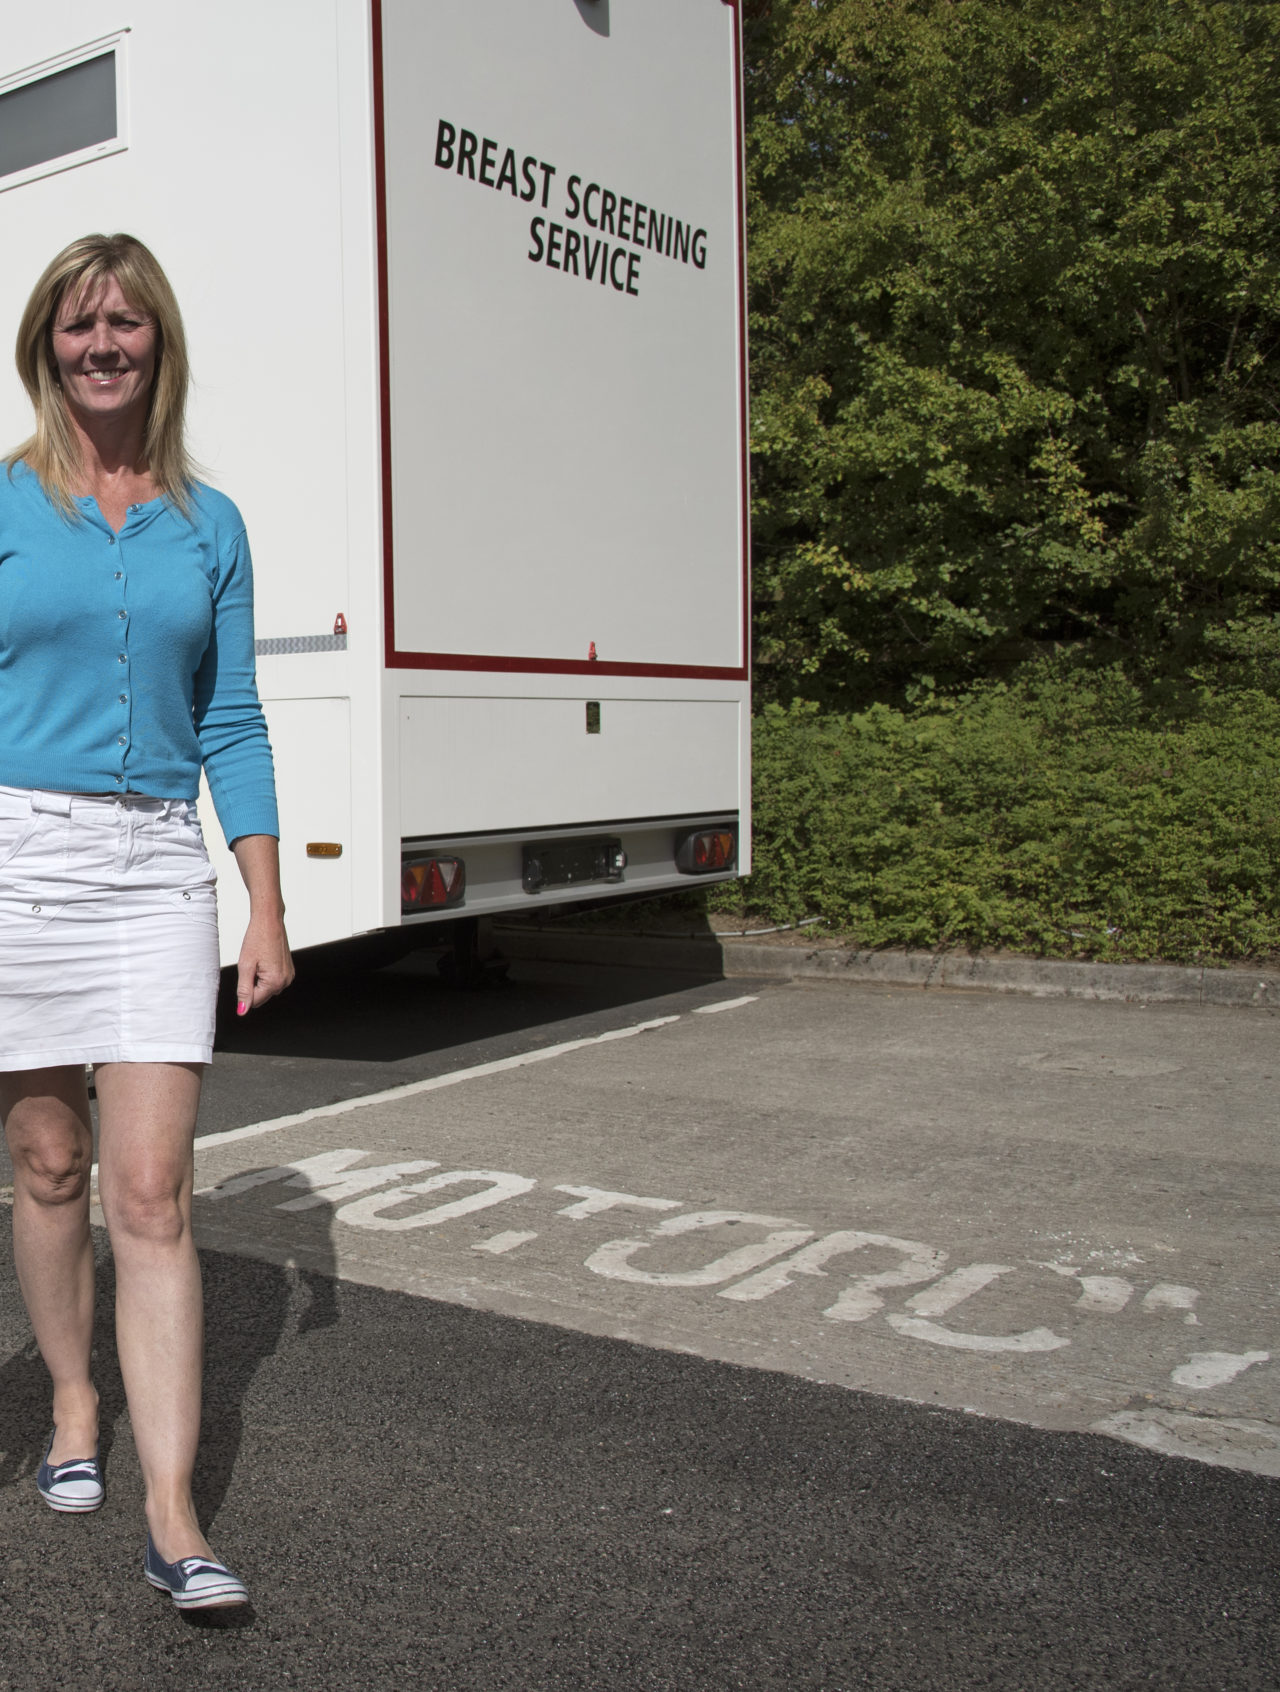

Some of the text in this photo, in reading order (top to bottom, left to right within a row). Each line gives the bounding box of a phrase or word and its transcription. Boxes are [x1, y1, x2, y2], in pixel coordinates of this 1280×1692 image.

[434, 118, 708, 270] BREAST SCREENING
[527, 216, 642, 297] SERVICE
